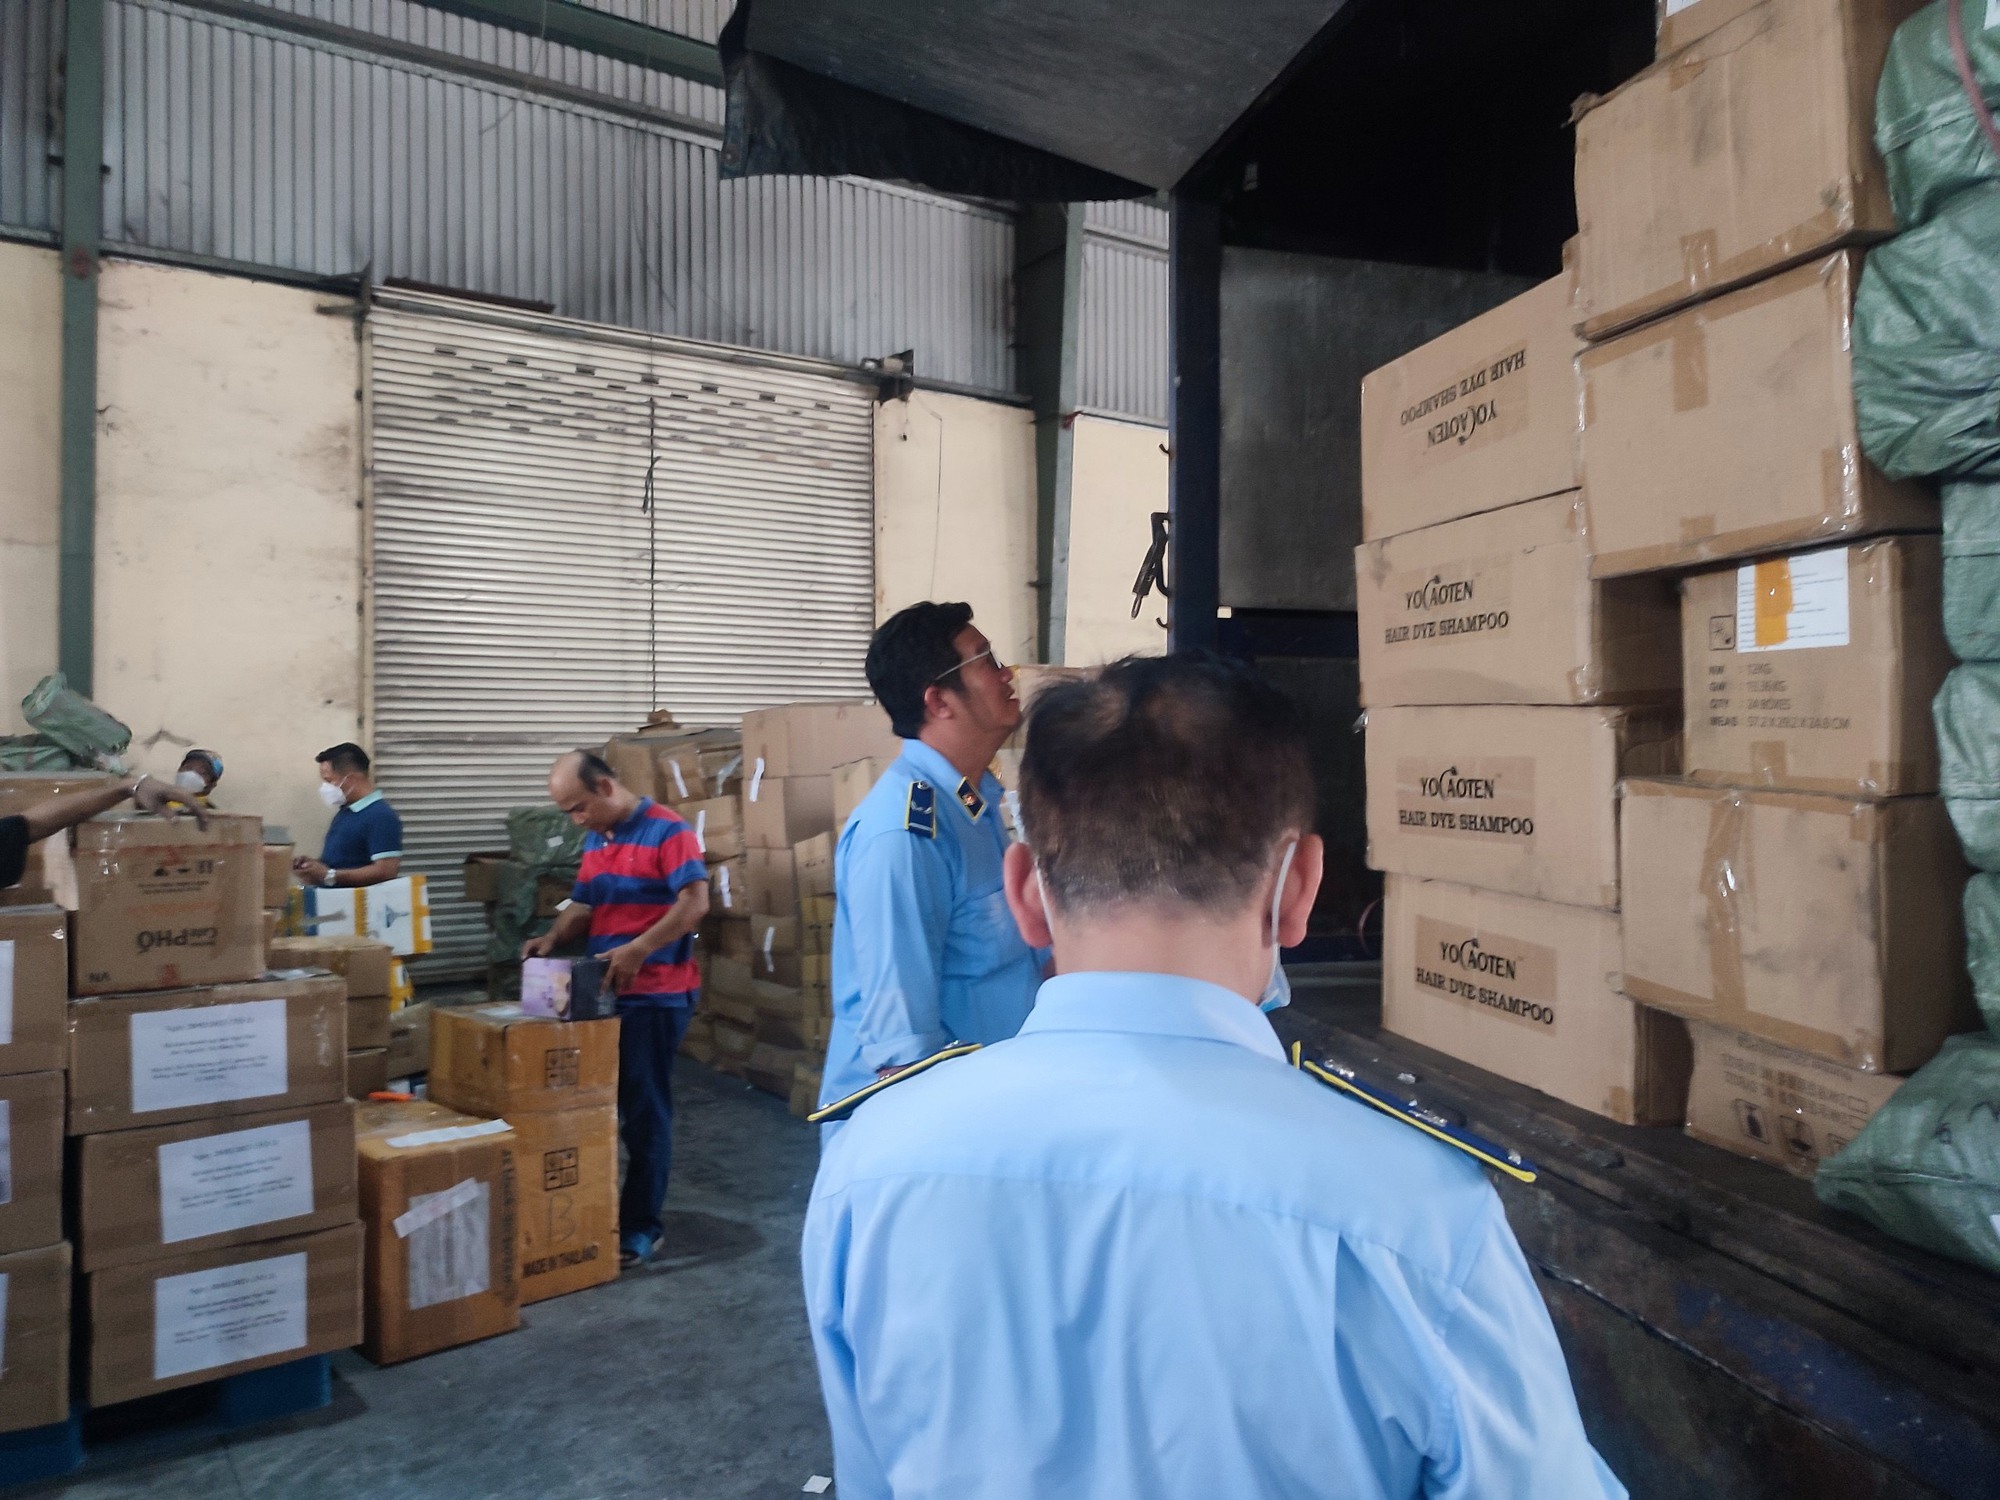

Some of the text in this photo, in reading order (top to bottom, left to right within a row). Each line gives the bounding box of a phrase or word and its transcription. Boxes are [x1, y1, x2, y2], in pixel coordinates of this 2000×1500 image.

[1401, 349, 1526, 425] HAIR DYE SHAMPOO
[1385, 611, 1509, 644] HAIR DYE SHAMPOO
[1399, 809, 1534, 836] HAIR DYE SHAMPOO
[1416, 967, 1554, 1025] HAIR DYE SHAMPOO
